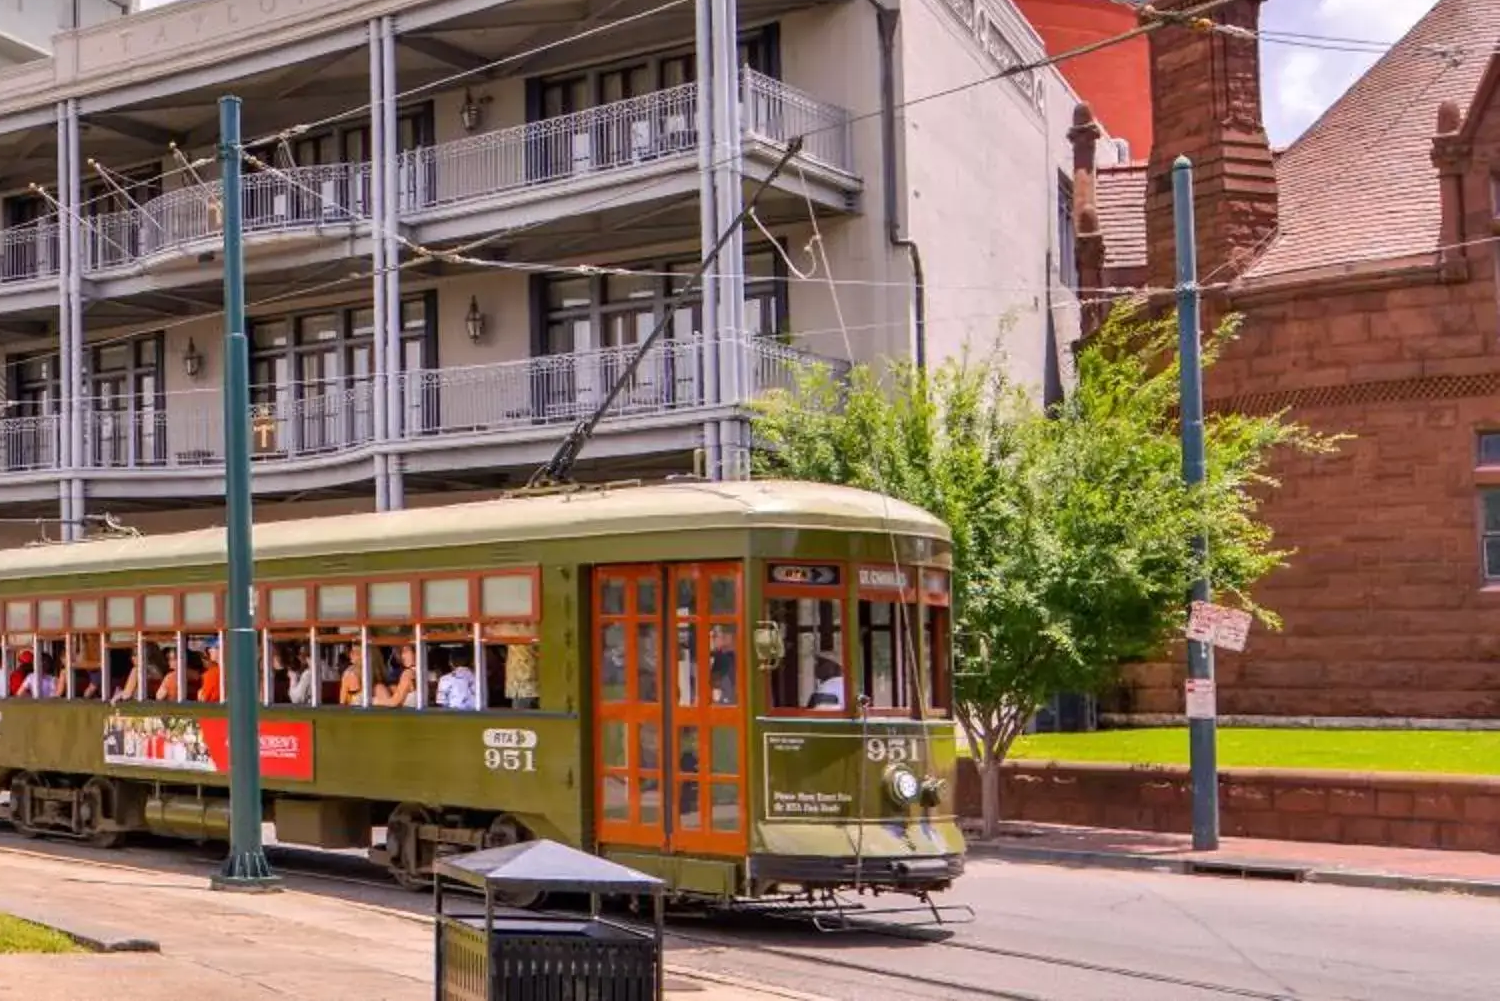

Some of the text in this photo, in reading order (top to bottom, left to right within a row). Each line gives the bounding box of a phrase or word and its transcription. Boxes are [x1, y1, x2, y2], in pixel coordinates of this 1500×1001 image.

[493, 732, 514, 744] RTA
[484, 748, 537, 771] 951
[867, 738, 921, 762] 951
